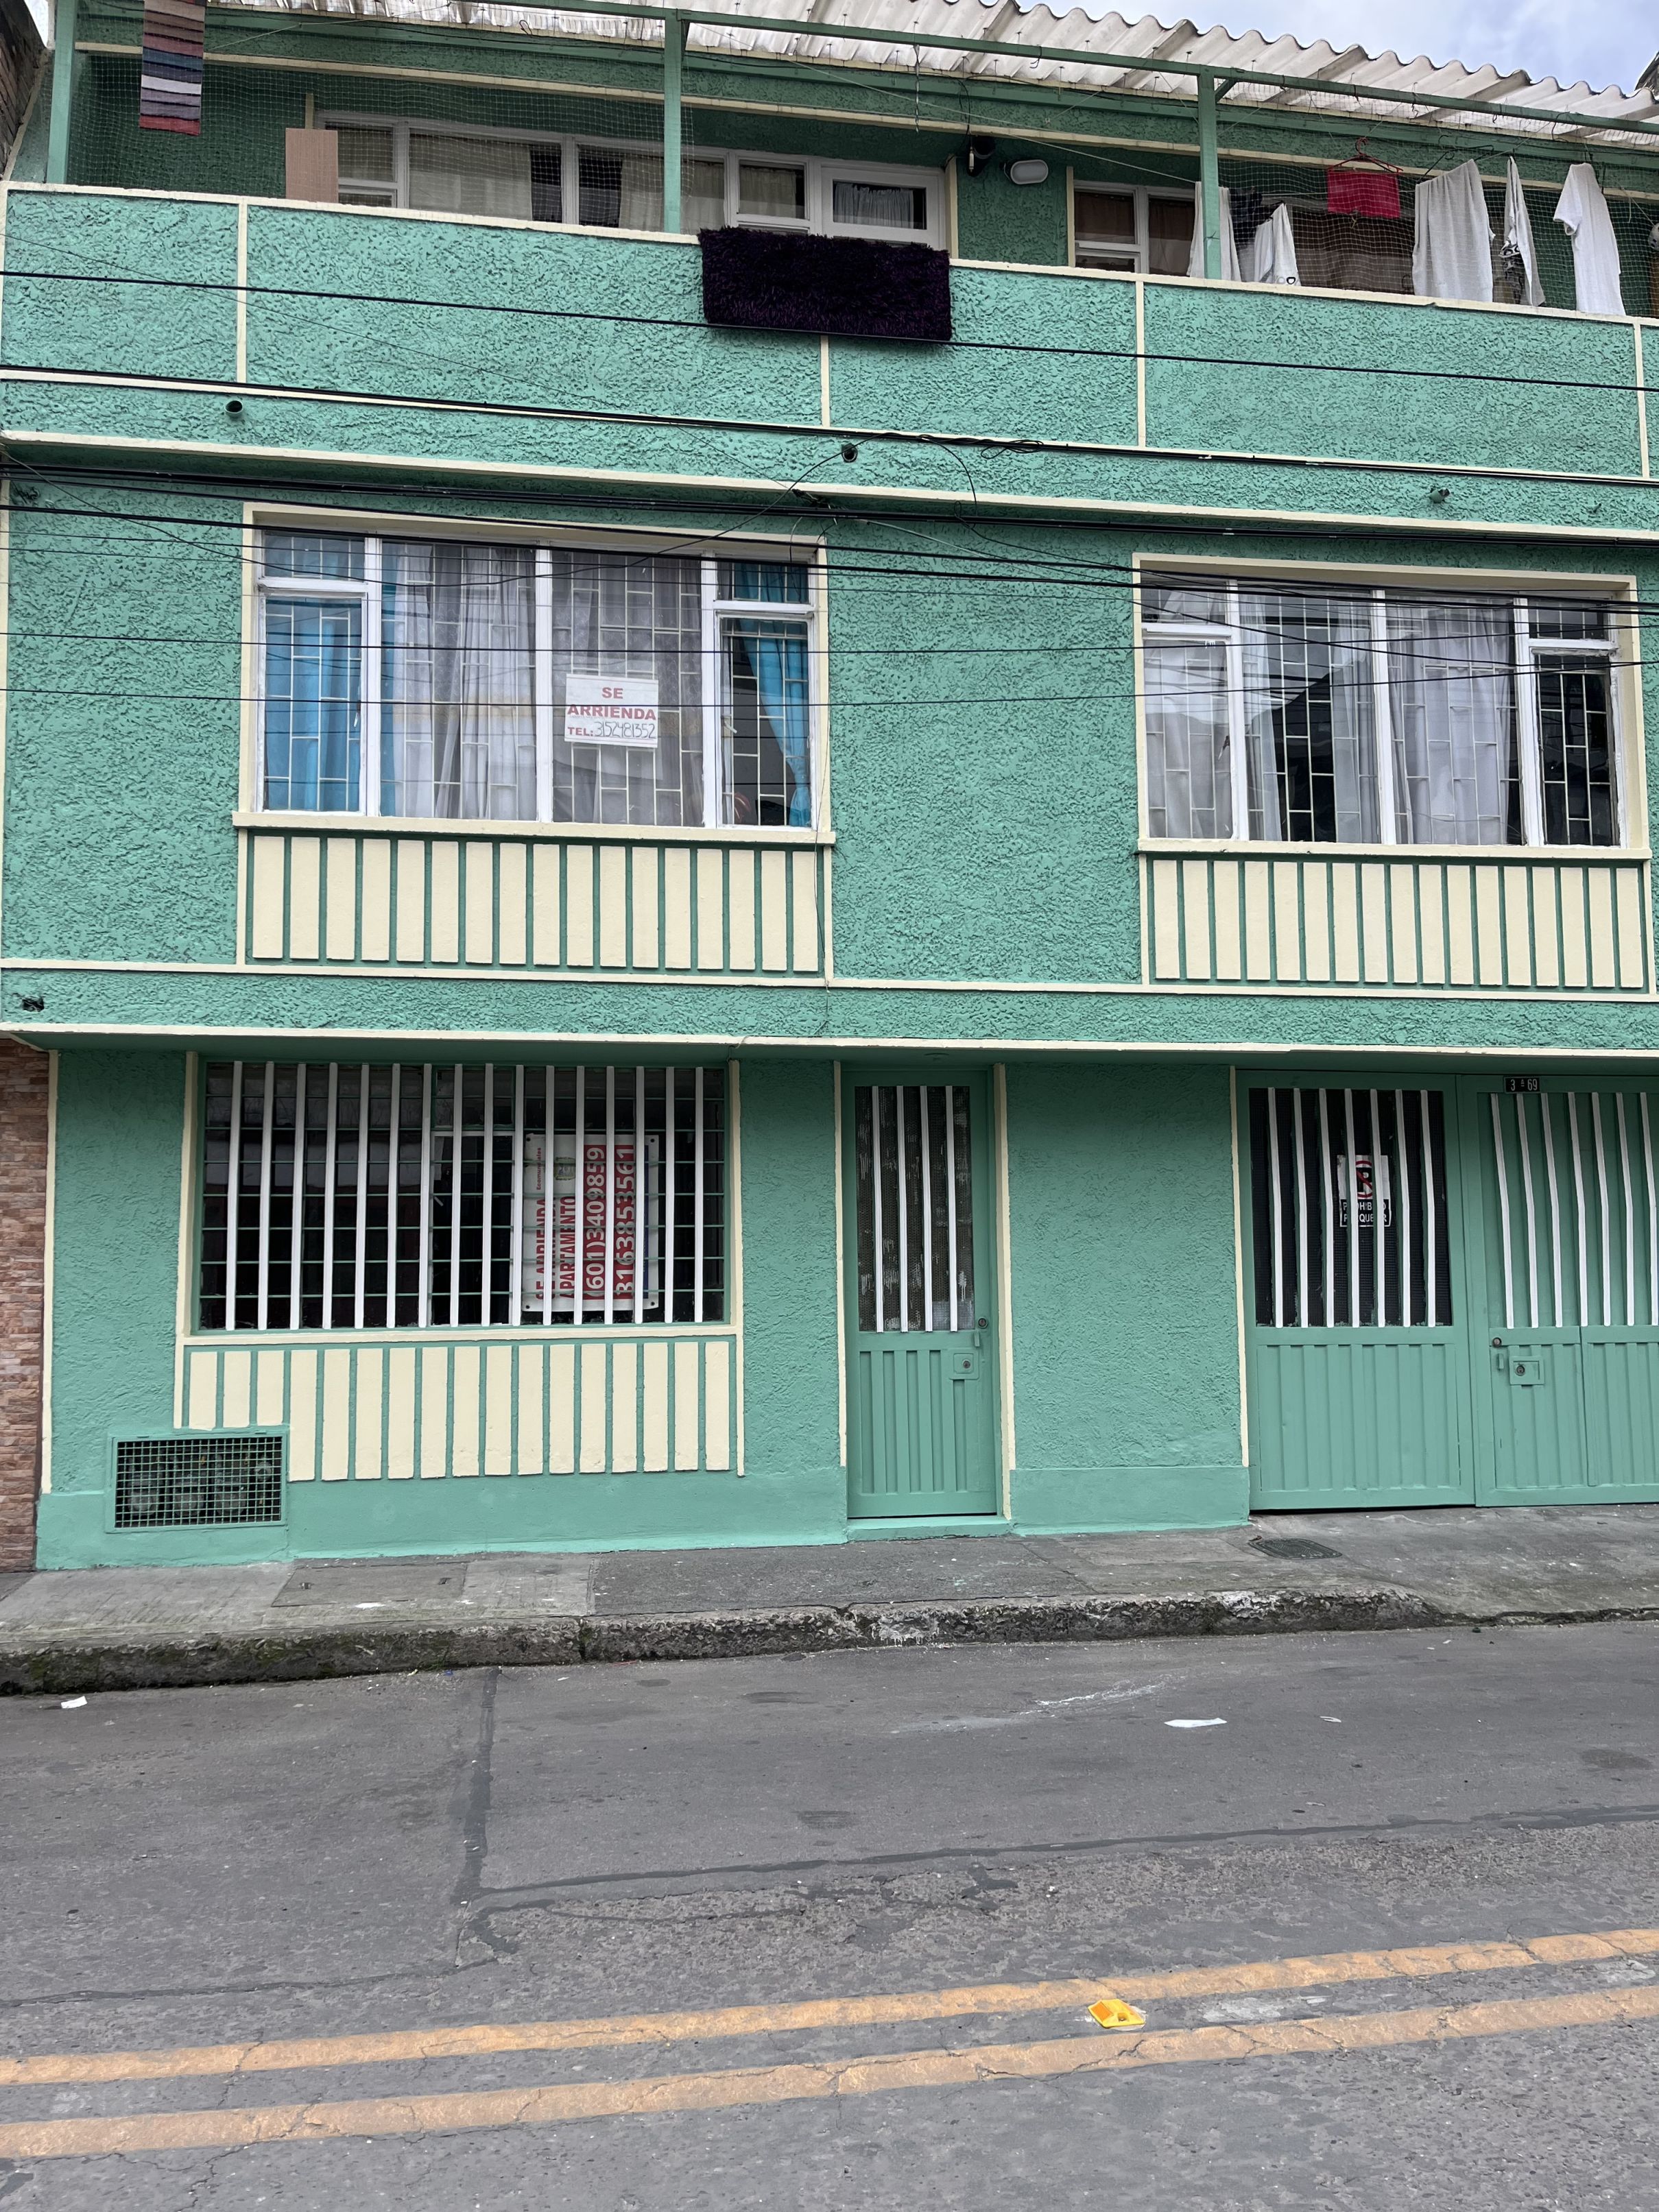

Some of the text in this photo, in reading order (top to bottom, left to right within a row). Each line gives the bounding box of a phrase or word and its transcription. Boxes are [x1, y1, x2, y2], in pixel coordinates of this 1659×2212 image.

[601, 687, 623, 699] SE
[567, 704, 656, 721] ARRIENDA
[567, 721, 656, 739] TEL: 3152481352
[1510, 1079, 1515, 1091] 3
[1527, 1079, 1538, 1091] 69
[586, 1147, 606, 1297] (601)3409859
[616, 1149, 635, 1295] 3163853561
[560, 1196, 576, 1299] APARTAMENTO
[536, 1280, 556, 1300] SE
